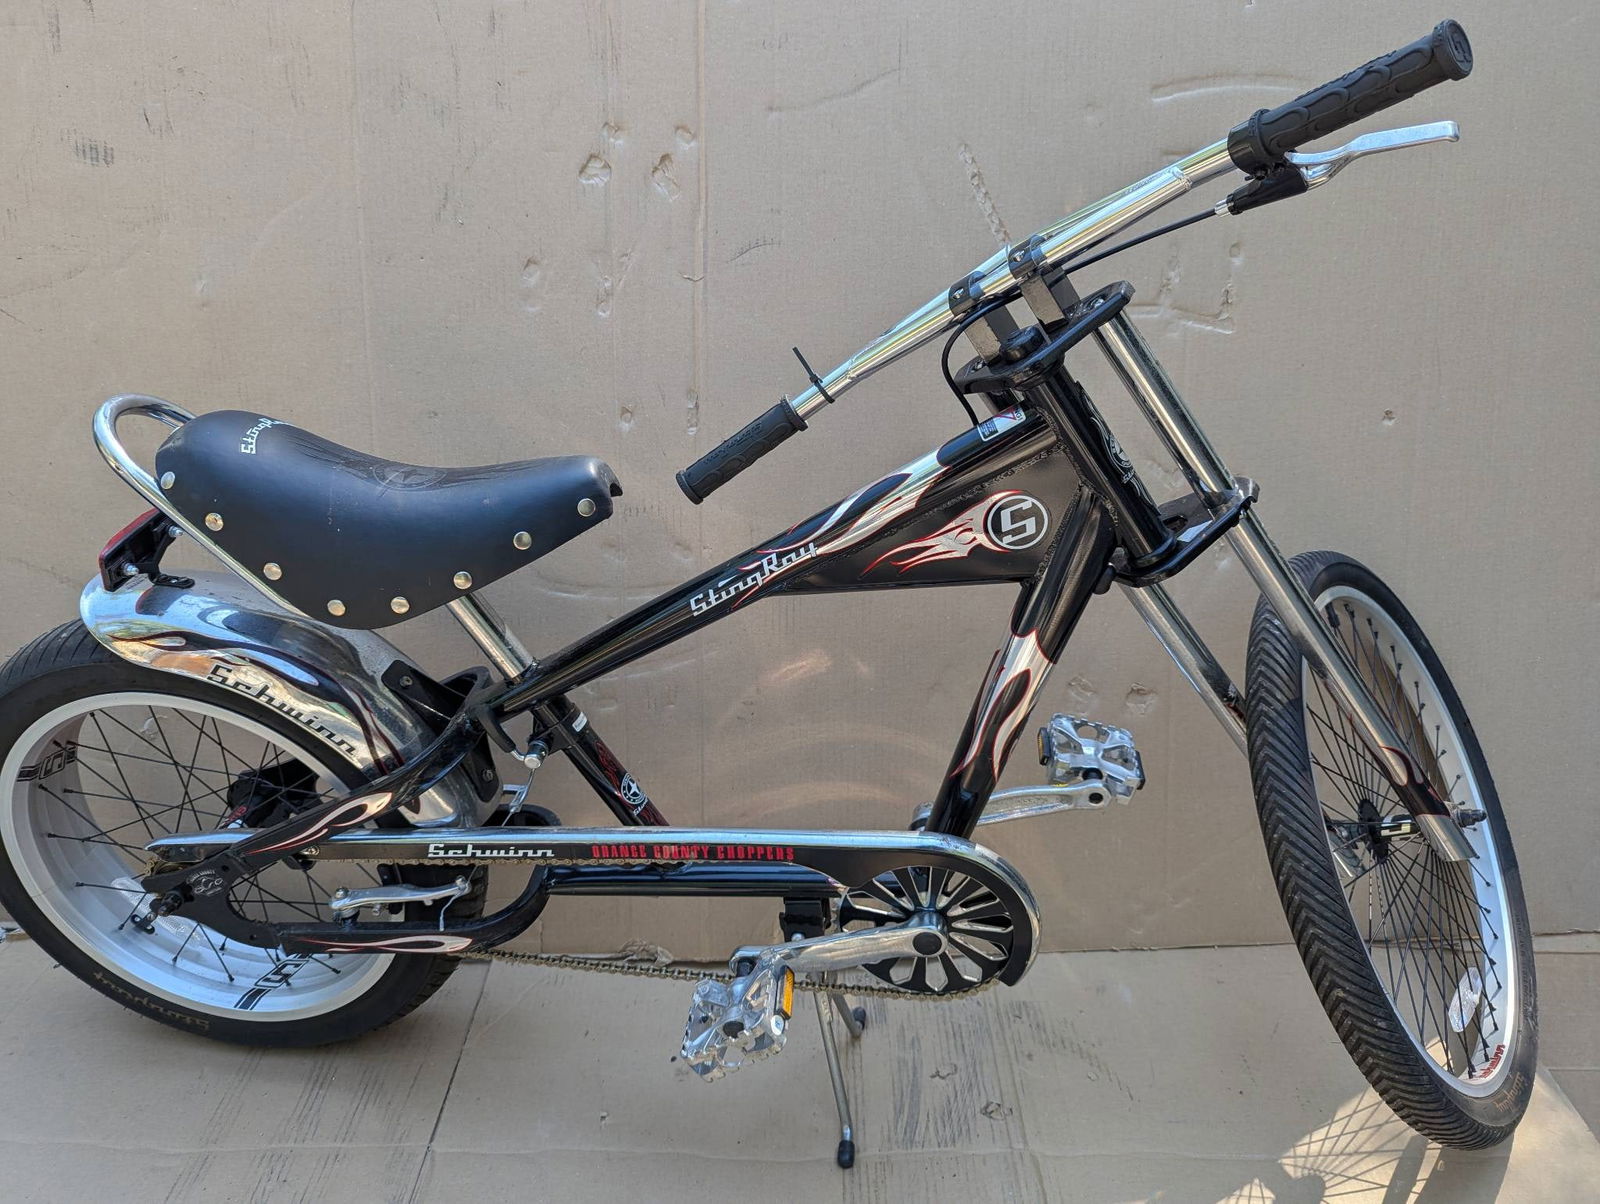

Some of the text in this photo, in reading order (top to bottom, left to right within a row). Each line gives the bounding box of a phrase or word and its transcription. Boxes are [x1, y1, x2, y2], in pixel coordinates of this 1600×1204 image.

[1000, 499, 1037, 545] S
[206, 664, 356, 756] Schwinn
[427, 843, 555, 858] Schwinn
[591, 844, 795, 861] ORANGE COUNTY CHOPPERS
